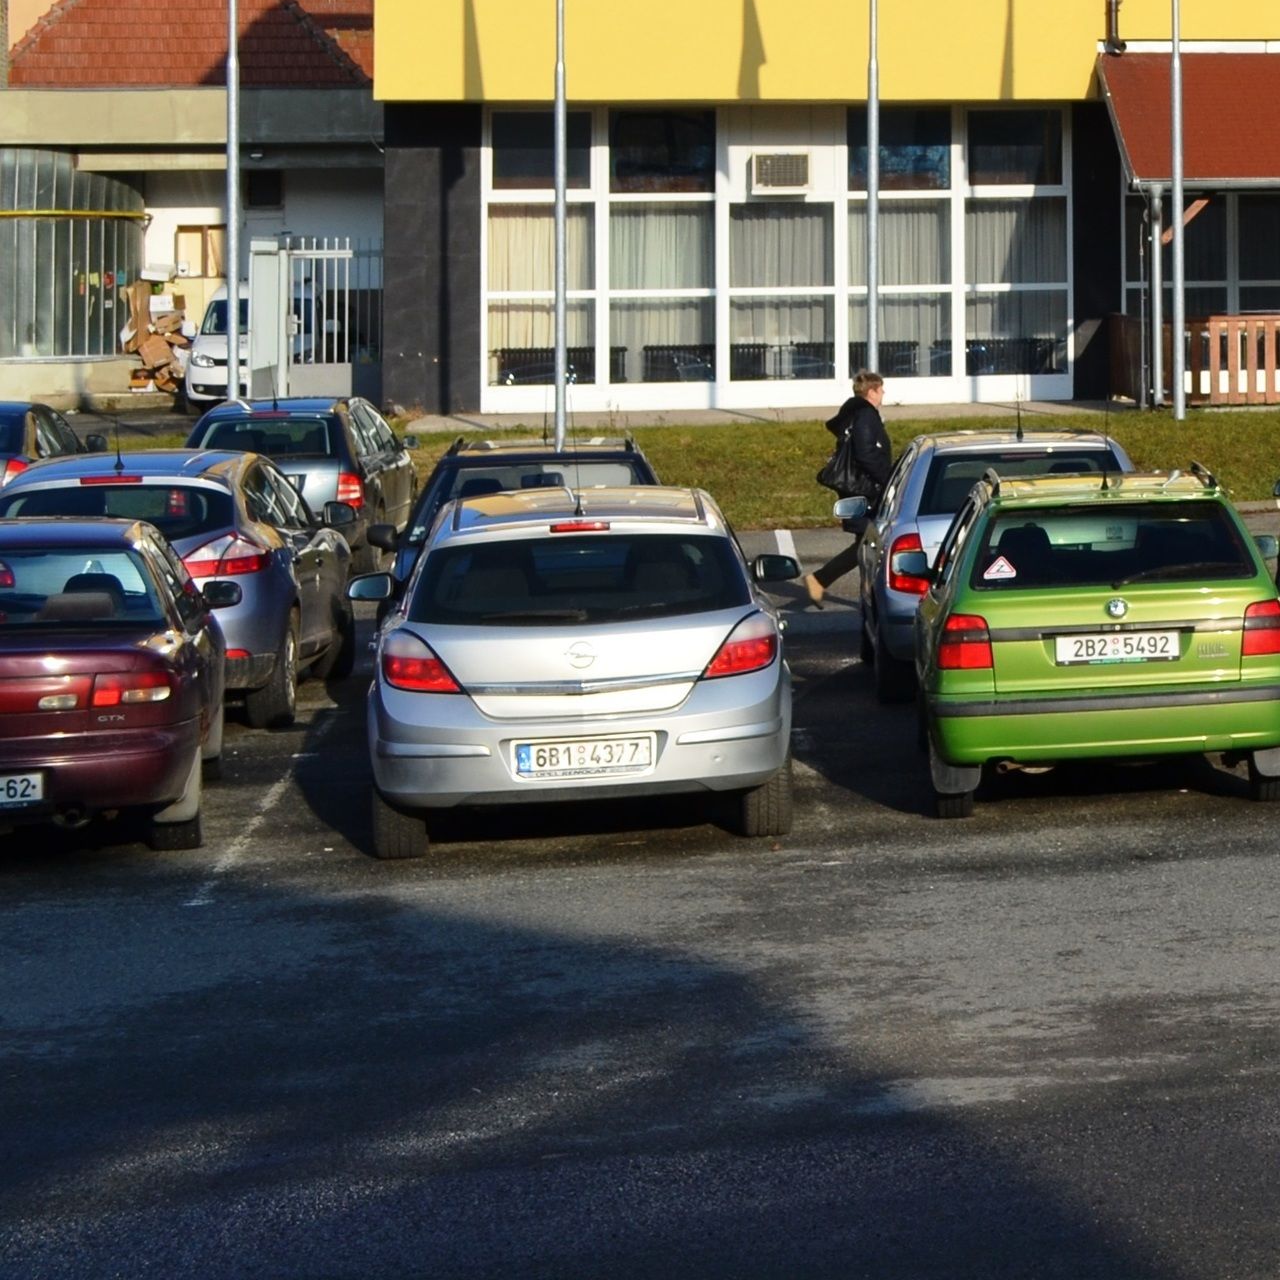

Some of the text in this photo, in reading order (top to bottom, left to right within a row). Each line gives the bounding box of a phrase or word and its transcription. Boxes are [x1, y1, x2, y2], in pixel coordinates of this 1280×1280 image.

[1073, 635, 1170, 658] 2B2 5492
[97, 714, 126, 722] GTX
[535, 742, 640, 767] 6B1 4377
